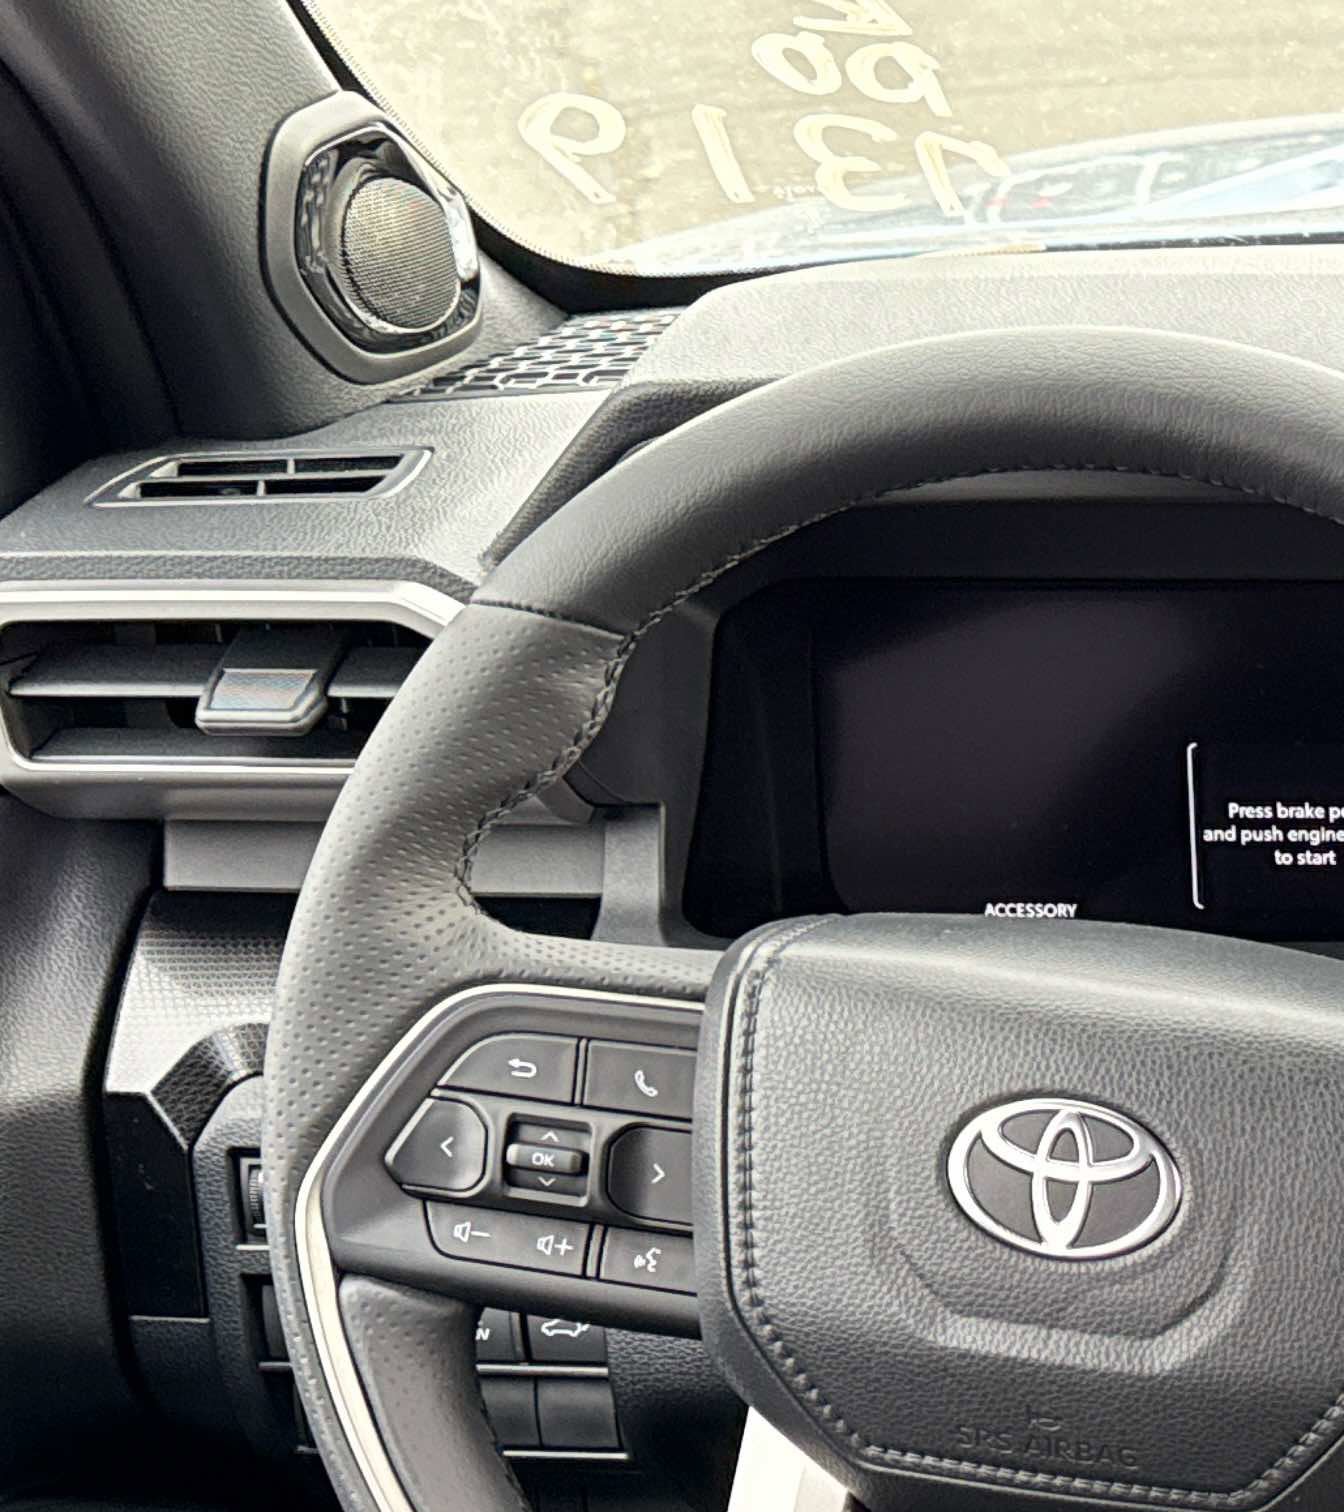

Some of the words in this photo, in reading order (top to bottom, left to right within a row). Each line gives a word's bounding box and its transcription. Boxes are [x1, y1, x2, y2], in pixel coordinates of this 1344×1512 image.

[1228, 802, 1273, 819] Press
[1276, 801, 1325, 819] brake
[1203, 825, 1237, 842] and
[1240, 825, 1284, 846] push
[1274, 849, 1293, 866] to
[1297, 850, 1337, 866] start
[984, 902, 1078, 918] ACCESSORY
[531, 1152, 555, 1168] OK
